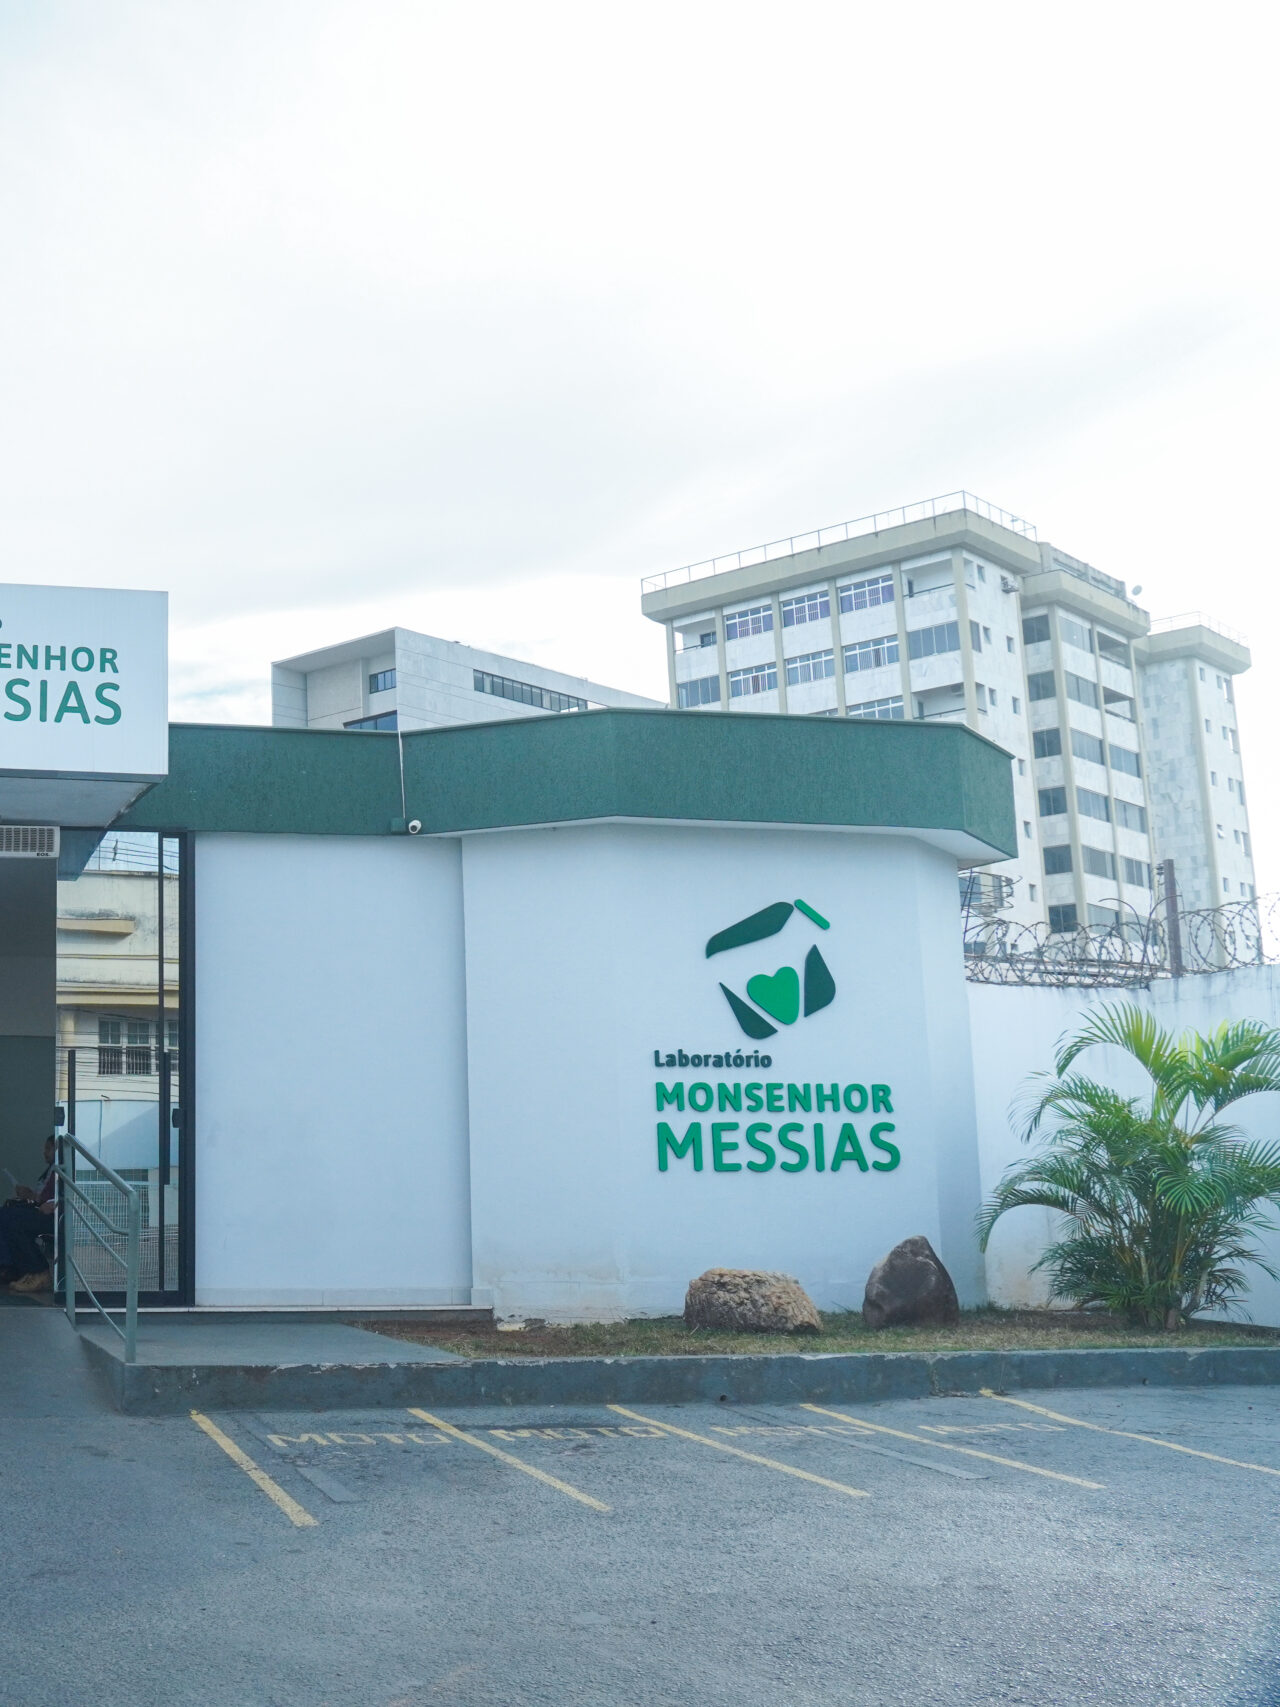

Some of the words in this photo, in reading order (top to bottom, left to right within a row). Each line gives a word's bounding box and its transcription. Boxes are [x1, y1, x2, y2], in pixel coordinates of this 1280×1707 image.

[654, 1048, 772, 1069] Laboratório
[655, 1082, 895, 1113] MONSENHOR
[656, 1121, 901, 1173] MESSIAS
[266, 1432, 452, 1447] MOTO
[487, 1426, 670, 1441] MOTO
[709, 1425, 876, 1437] MOTO
